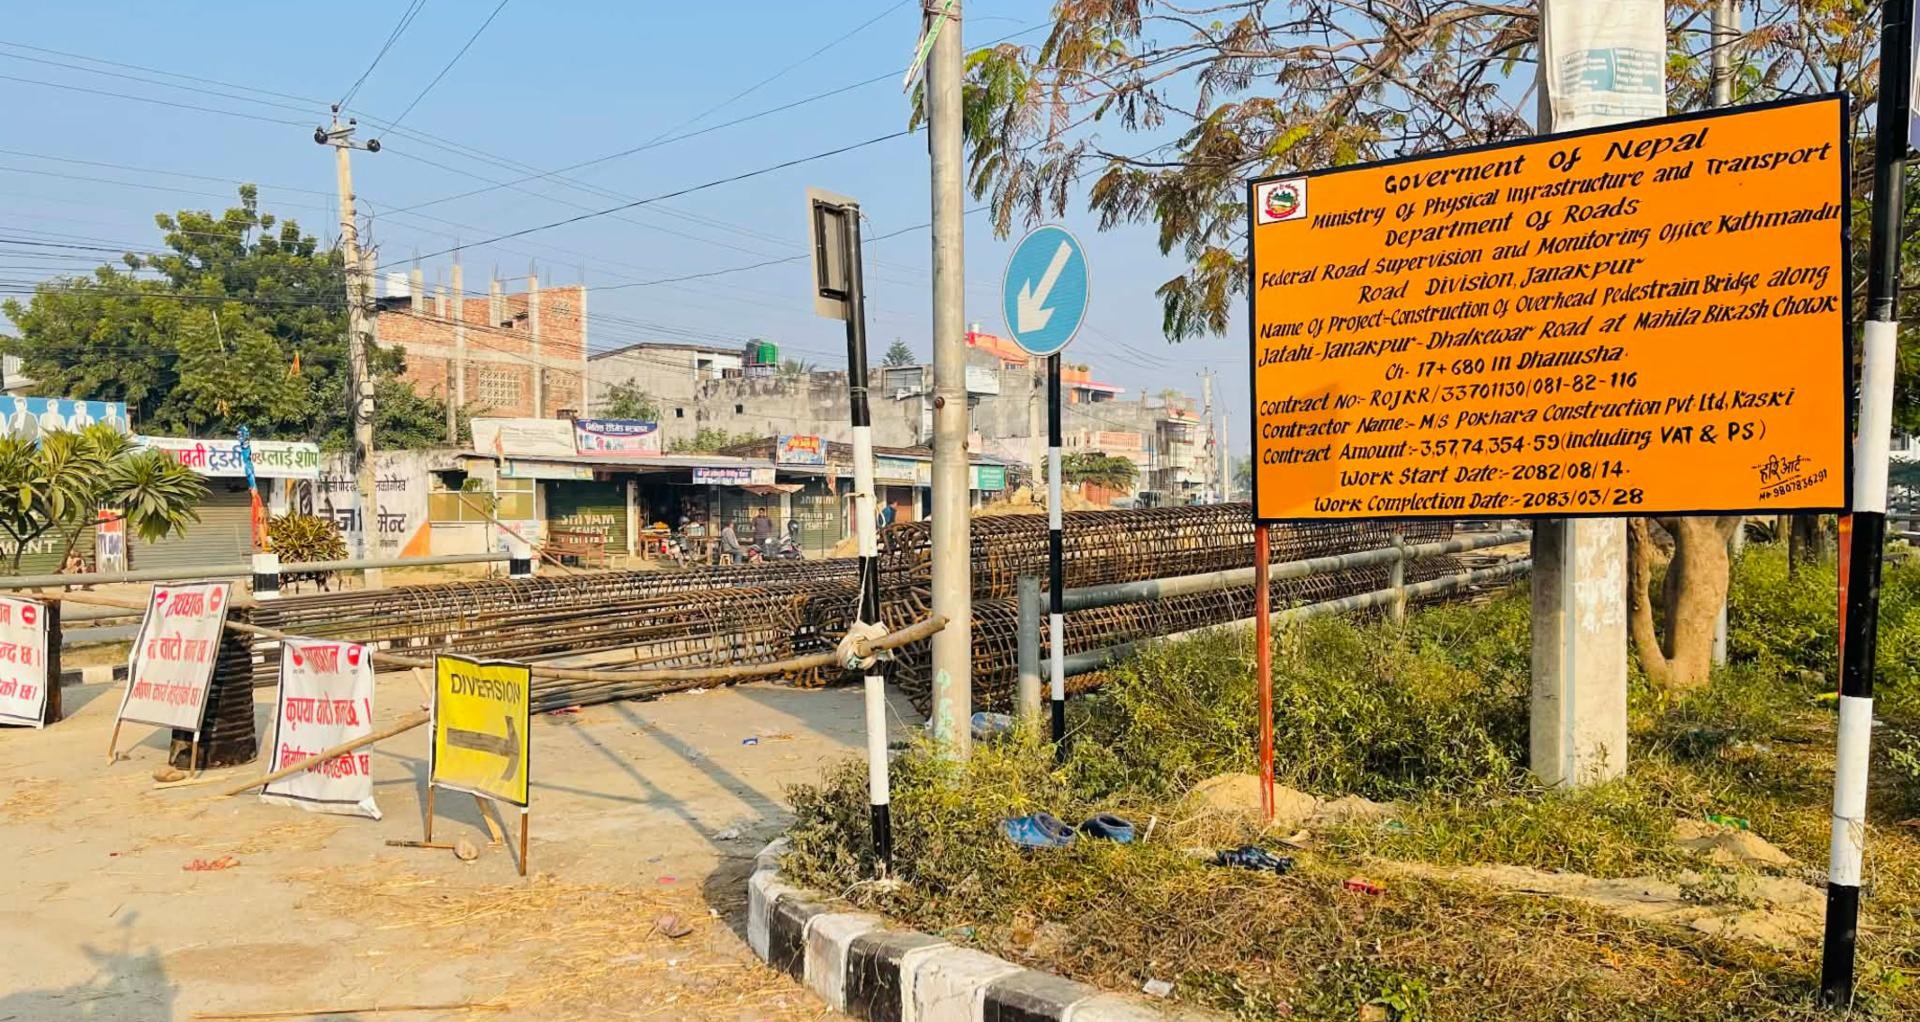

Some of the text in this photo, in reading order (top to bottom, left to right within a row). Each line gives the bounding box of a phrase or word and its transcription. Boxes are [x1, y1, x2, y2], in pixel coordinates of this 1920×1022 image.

[1385, 154, 1526, 194] Goverment
[1604, 127, 1710, 162] Nepal
[1311, 207, 1386, 230] Ministry
[1423, 189, 1499, 217] Physical
[1652, 161, 1693, 183] and
[1707, 141, 1832, 175] Transport
[1260, 201, 1842, 290] Federal Road Supervision and Monitoring Office Kathmandu
[1385, 211, 1513, 247] Department
[1562, 197, 1643, 224] Roads
[1260, 322, 1302, 339] Name
[1516, 288, 1596, 311] Overhead
[1602, 276, 1700, 306] Pedestrain
[1702, 271, 1760, 297] Bridge
[1767, 264, 1831, 291] along
[1357, 280, 1410, 304] Road
[1520, 257, 1645, 288] Janakpur
[1539, 315, 1594, 339] Road
[1599, 313, 1627, 333] at
[1634, 307, 1701, 330] Mahila
[1703, 300, 1768, 323] Bikash
[1772, 292, 1838, 315] Chowk
[1260, 392, 1330, 417] Contract
[1262, 420, 1351, 440] Contractor
[1418, 412, 1449, 430] M/S
[1455, 408, 1537, 429] Pokhara
[1543, 399, 1661, 423] Construction
[1731, 387, 1796, 409] Kaski
[1263, 445, 1331, 465] Contract
[1660, 426, 1694, 445] VAT
[1699, 424, 1718, 444] &
[1340, 466, 1393, 487] Work
[1399, 465, 1449, 486] Start
[1315, 496, 1362, 512] Work
[1367, 492, 1465, 515] Complection
[451, 673, 521, 704] DIVERSION
[286, 697, 315, 731] कृपया
